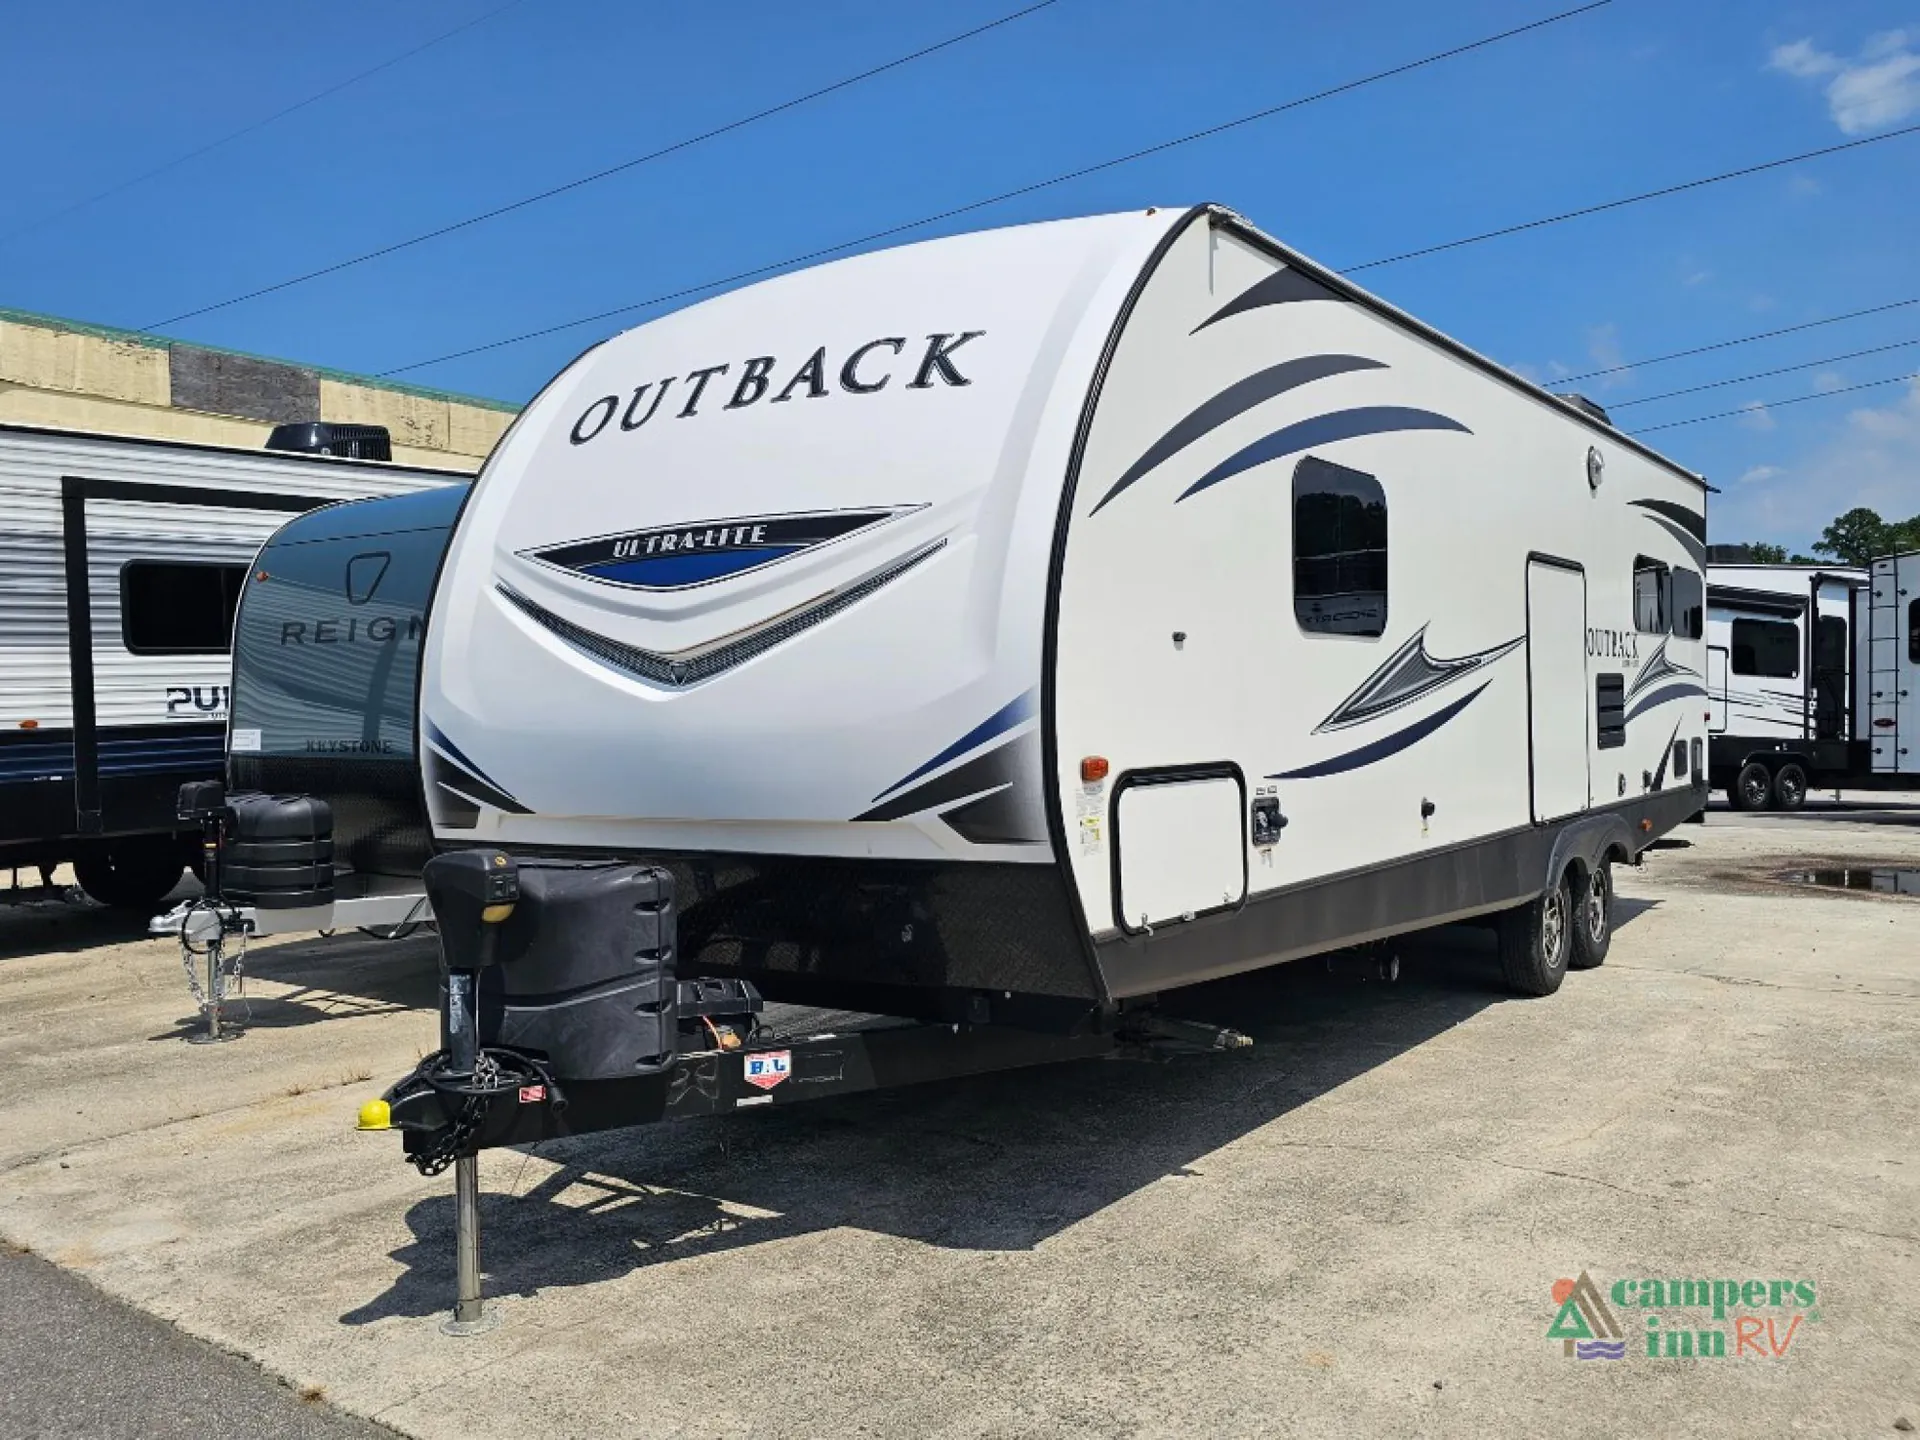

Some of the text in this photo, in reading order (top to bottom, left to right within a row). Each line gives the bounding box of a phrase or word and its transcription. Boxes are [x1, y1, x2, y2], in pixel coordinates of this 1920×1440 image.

[569, 329, 987, 446] OUTBACK
[612, 524, 768, 558] ULTRA-LITE
[1587, 627, 1639, 658] OUTBACK
[166, 686, 230, 712] PU
[305, 738, 396, 755] KEYSTONE
